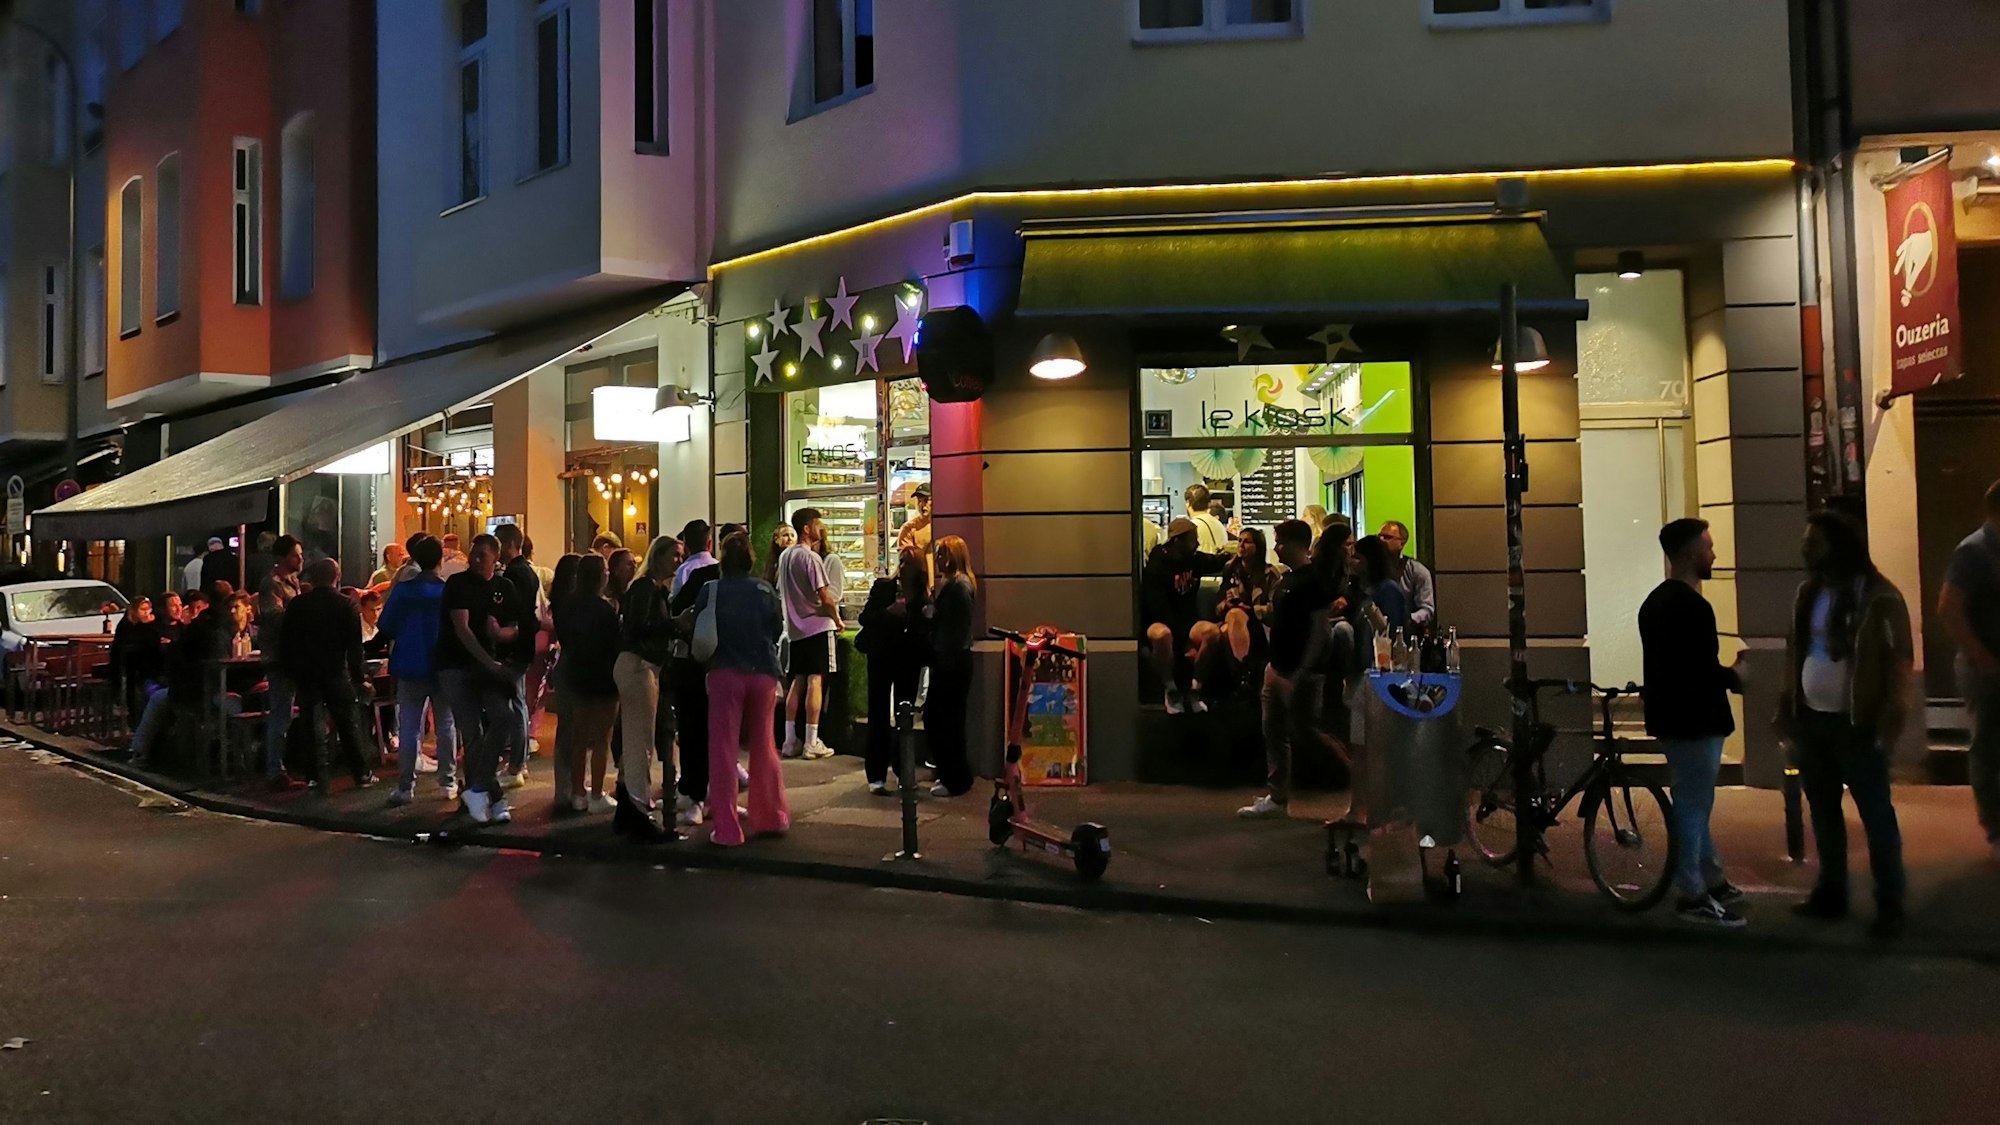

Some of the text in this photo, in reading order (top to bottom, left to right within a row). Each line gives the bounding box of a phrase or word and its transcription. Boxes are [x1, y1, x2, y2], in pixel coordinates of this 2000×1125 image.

[1896, 313, 1950, 348] Ouzeria
[1202, 398, 1349, 429] le kiosk
[798, 440, 812, 464] le
